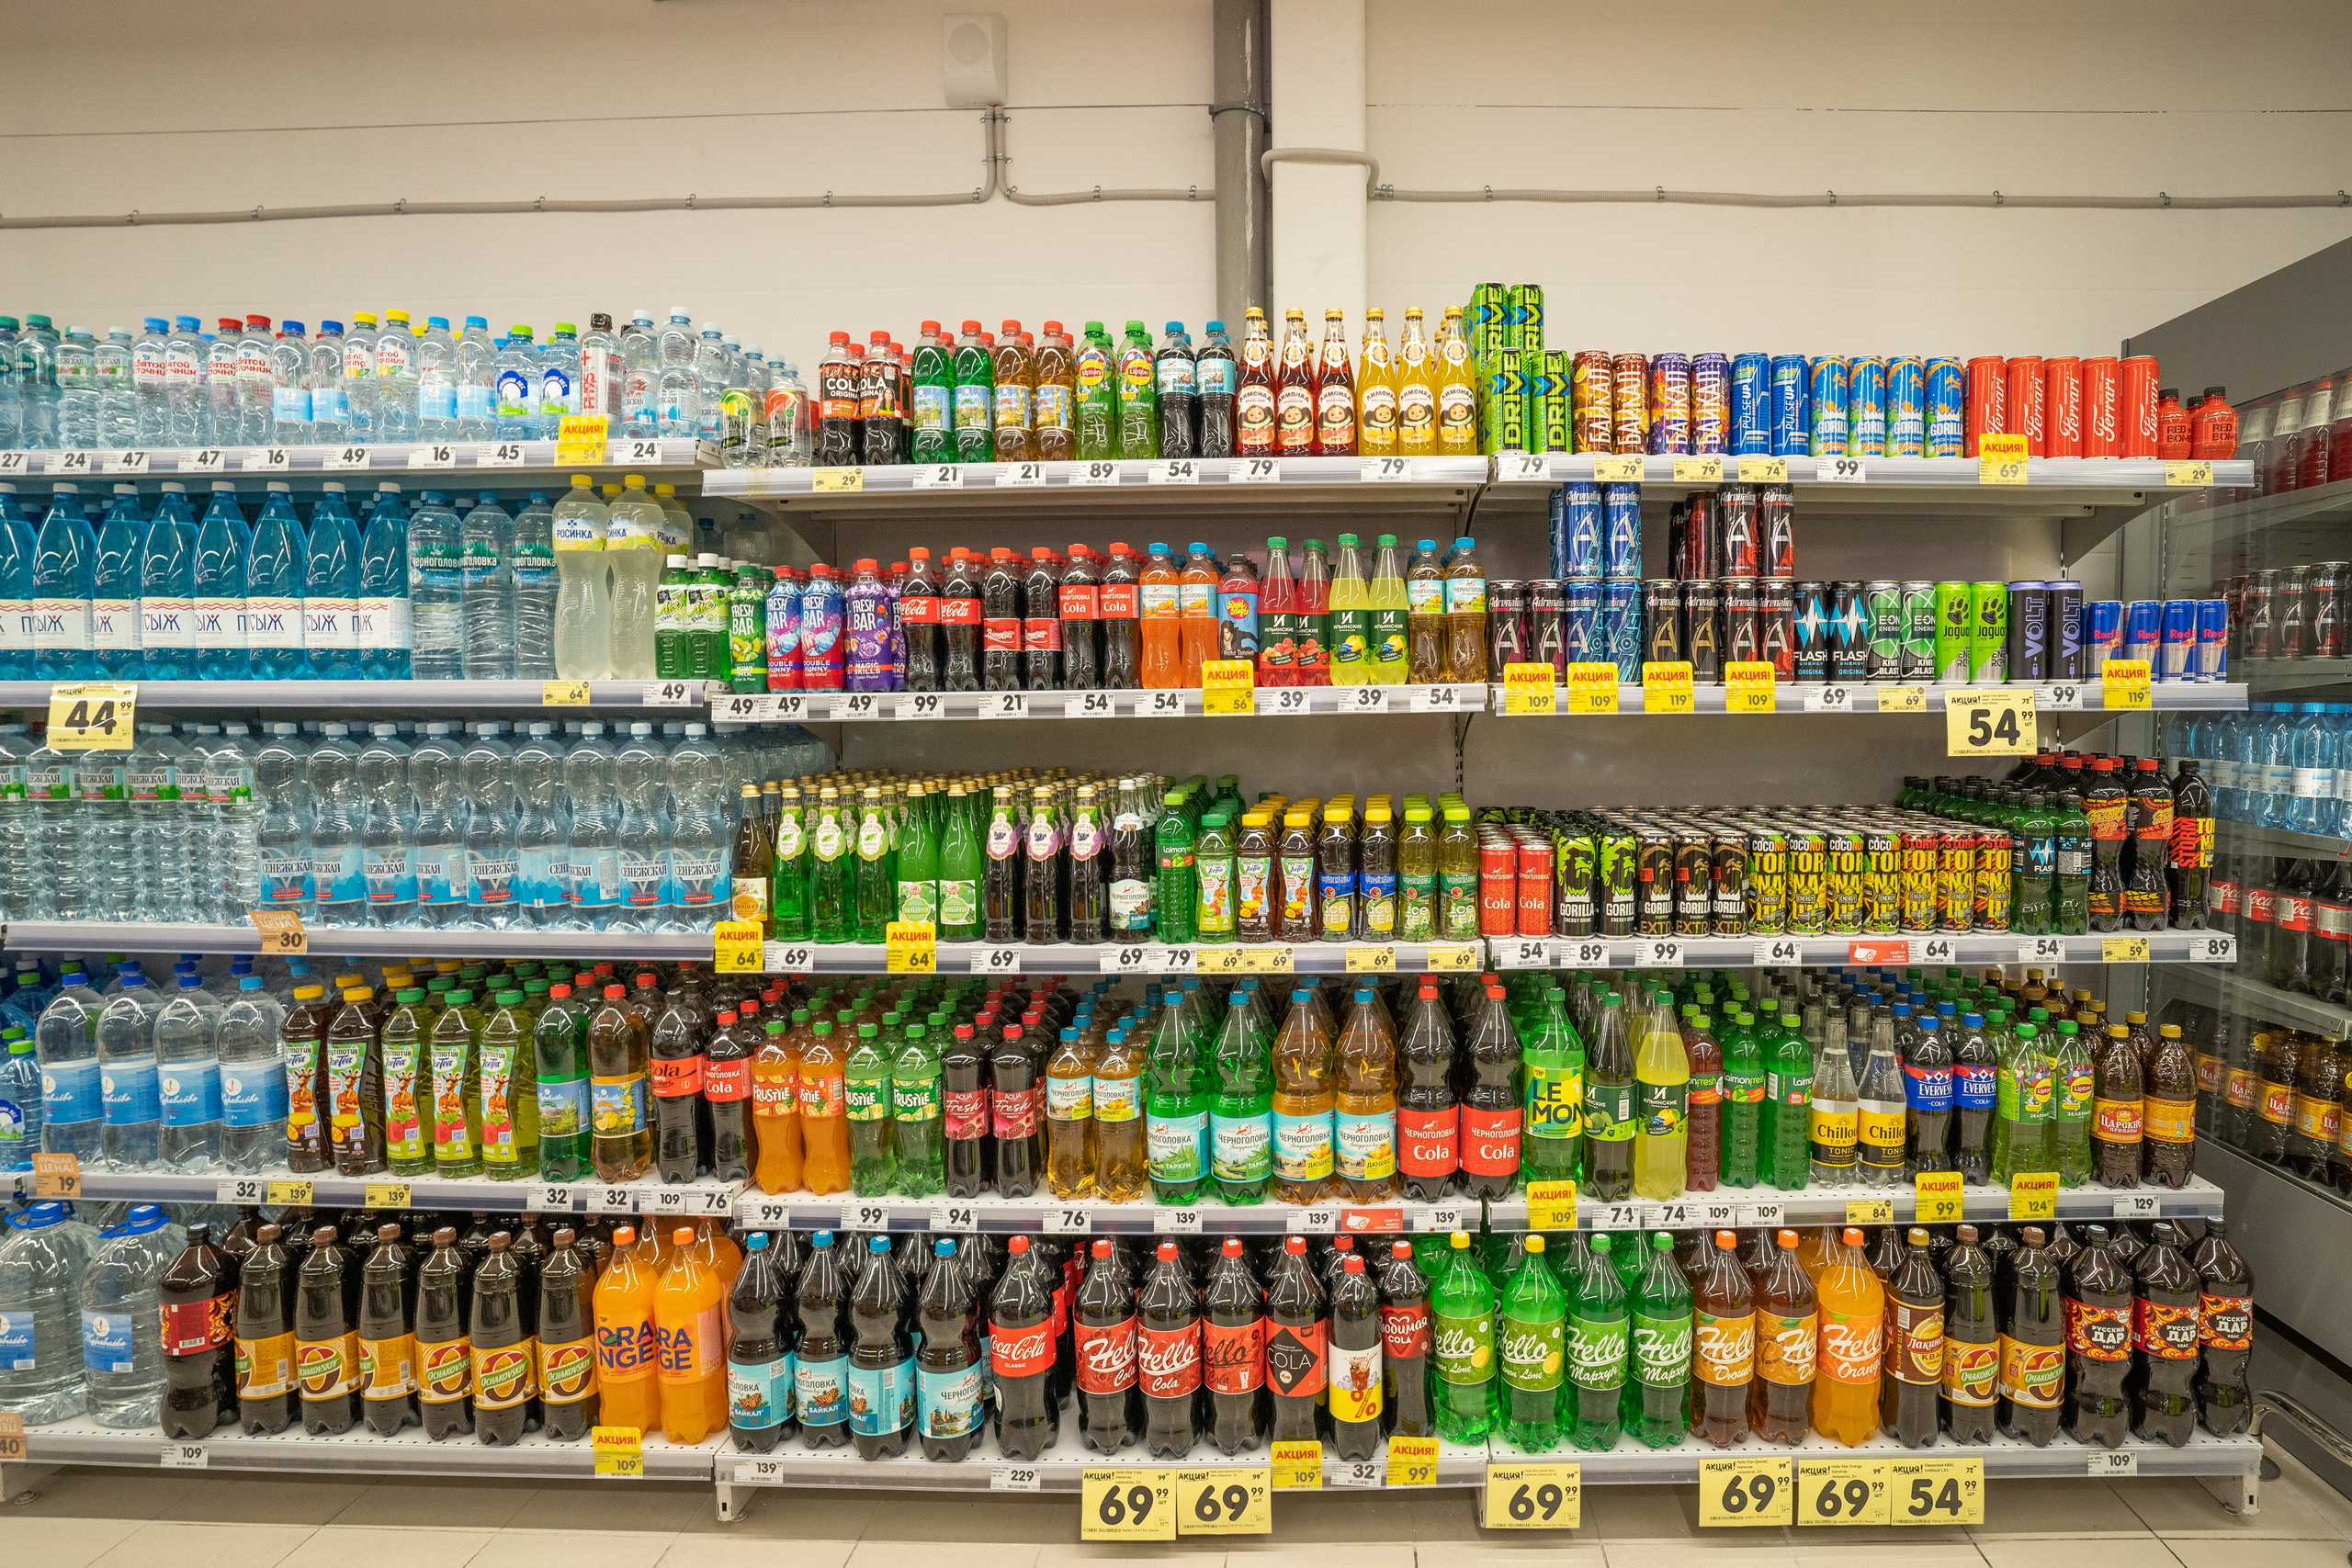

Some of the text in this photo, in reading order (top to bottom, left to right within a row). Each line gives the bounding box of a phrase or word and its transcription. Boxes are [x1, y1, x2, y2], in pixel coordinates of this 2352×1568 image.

[1505, 355, 1523, 445] DRIVE
[1549, 353, 1565, 445] DRIVE
[563, 424, 603, 434] АКЦИЯ!
[2166, 425, 2186, 434] RED
[343, 448, 365, 462] 49
[634, 443, 656, 457] 24
[1984, 443, 2024, 455] АКЦИЯ!
[64, 453, 85, 467] 24
[1250, 459, 1272, 475] 79
[1520, 457, 1543, 472] 79
[939, 467, 957, 481] 21
[1090, 463, 1114, 478] 89
[1169, 462, 1193, 477] 54
[1836, 460, 1858, 475] 99
[557, 530, 592, 539] РОСИНКА
[732, 605, 753, 616] FRESH
[853, 600, 874, 613] FRESH
[1103, 602, 1126, 612] Cola
[733, 621, 754, 635] BAR
[854, 615, 876, 631] BAR
[2062, 597, 2080, 658] VOLT
[1793, 650, 1827, 661] FLASH
[1206, 669, 1250, 680] АКЦИЯ!
[1509, 671, 1550, 682] АКЦИЯ!
[2107, 670, 2146, 678] АКЦИЯ!
[662, 683, 684, 699] 49
[1430, 688, 1453, 705] 54
[1824, 688, 1845, 704] 69
[2053, 686, 2075, 702] 99
[2128, 693, 2144, 702] 119
[915, 695, 937, 712] 99
[1003, 694, 1021, 711] 21
[1084, 694, 1108, 710] 54
[1281, 691, 1303, 707] 39
[1670, 694, 1687, 705] 119
[1951, 696, 1980, 705] АКЦИЯ!
[65, 700, 117, 735] 44
[1968, 709, 2020, 746] 54
[2179, 818, 2198, 867] STORM
[674, 863, 721, 874] СЕНЕЖСКАЯ
[1485, 897, 1510, 909] Cola
[1560, 904, 1594, 917] GORILLA
[1406, 915, 1430, 925] TEA
[281, 932, 301, 947] 30
[718, 931, 759, 942] АКЦИЯ!
[1580, 945, 1602, 961] 89
[1655, 943, 1677, 959] 99
[1927, 941, 1949, 957] 64
[2037, 940, 2058, 955] 54
[2209, 940, 2229, 955] 89
[737, 953, 755, 965] 64
[786, 949, 807, 964] 69
[1120, 948, 1142, 964] 69
[707, 1080, 731, 1093] Cola
[1532, 1079, 1563, 1101] LE
[2073, 1085, 2092, 1093] Lipton
[946, 1100, 983, 1112] Fresh
[1532, 1104, 1582, 1123] MON
[2100, 1113, 2143, 1128] ЦАРСКИЕ
[1279, 1131, 1330, 1142] ЧЕРНОГОЛОВКА
[1405, 1128, 1456, 1138] ЧЕРНОГОЛОВКА
[1414, 1145, 1449, 1159] Cola
[1308, 1159, 1331, 1168] ДЮШЕС
[59, 1176, 75, 1190] 19
[237, 1181, 255, 1197] 32
[290, 1190, 306, 1199] 139
[660, 1194, 680, 1204] 109
[1532, 1190, 1572, 1201] АКЦИЯ!
[1937, 1201, 1954, 1215] 99
[2029, 1201, 2047, 1212] 124
[2134, 1199, 2154, 1209] 129
[762, 1205, 783, 1220] 99
[1063, 1211, 1084, 1226] 76
[1663, 1206, 1685, 1222] 74
[1758, 1207, 1777, 1217] 109
[2092, 1325, 2124, 1334] РУССКИЙ
[1388, 1336, 1412, 1344] COLA
[1567, 1327, 1627, 1361] Hello
[2092, 1333, 2124, 1343] ДАР
[989, 1331, 1048, 1360] Coca-Cola
[481, 1362, 527, 1387] OCHAKOVSKIY
[548, 1358, 592, 1382] OCHAKOVSKIY
[1153, 1378, 1179, 1391] Cola
[809, 1404, 840, 1416] БАЙКАЛ
[182, 1448, 202, 1459] 109
[1393, 1445, 1435, 1456] АКЦИЯ!
[616, 1461, 636, 1470] 109
[1705, 1461, 1736, 1472] АКЦИЯ!
[2109, 1455, 2130, 1466] 109
[1011, 1470, 1034, 1481] 229
[1084, 1472, 1115, 1481] АКЦИЯ!
[1352, 1464, 1374, 1479] 32
[1408, 1467, 1428, 1481] 99
[1893, 1465, 1924, 1474] АКЦИЯ!
[1722, 1475, 1775, 1513] 69
[1816, 1480, 1869, 1517] 69
[1908, 1479, 1962, 1516] 54
[1100, 1485, 1153, 1525] 69
[1509, 1484, 1562, 1520] 69
